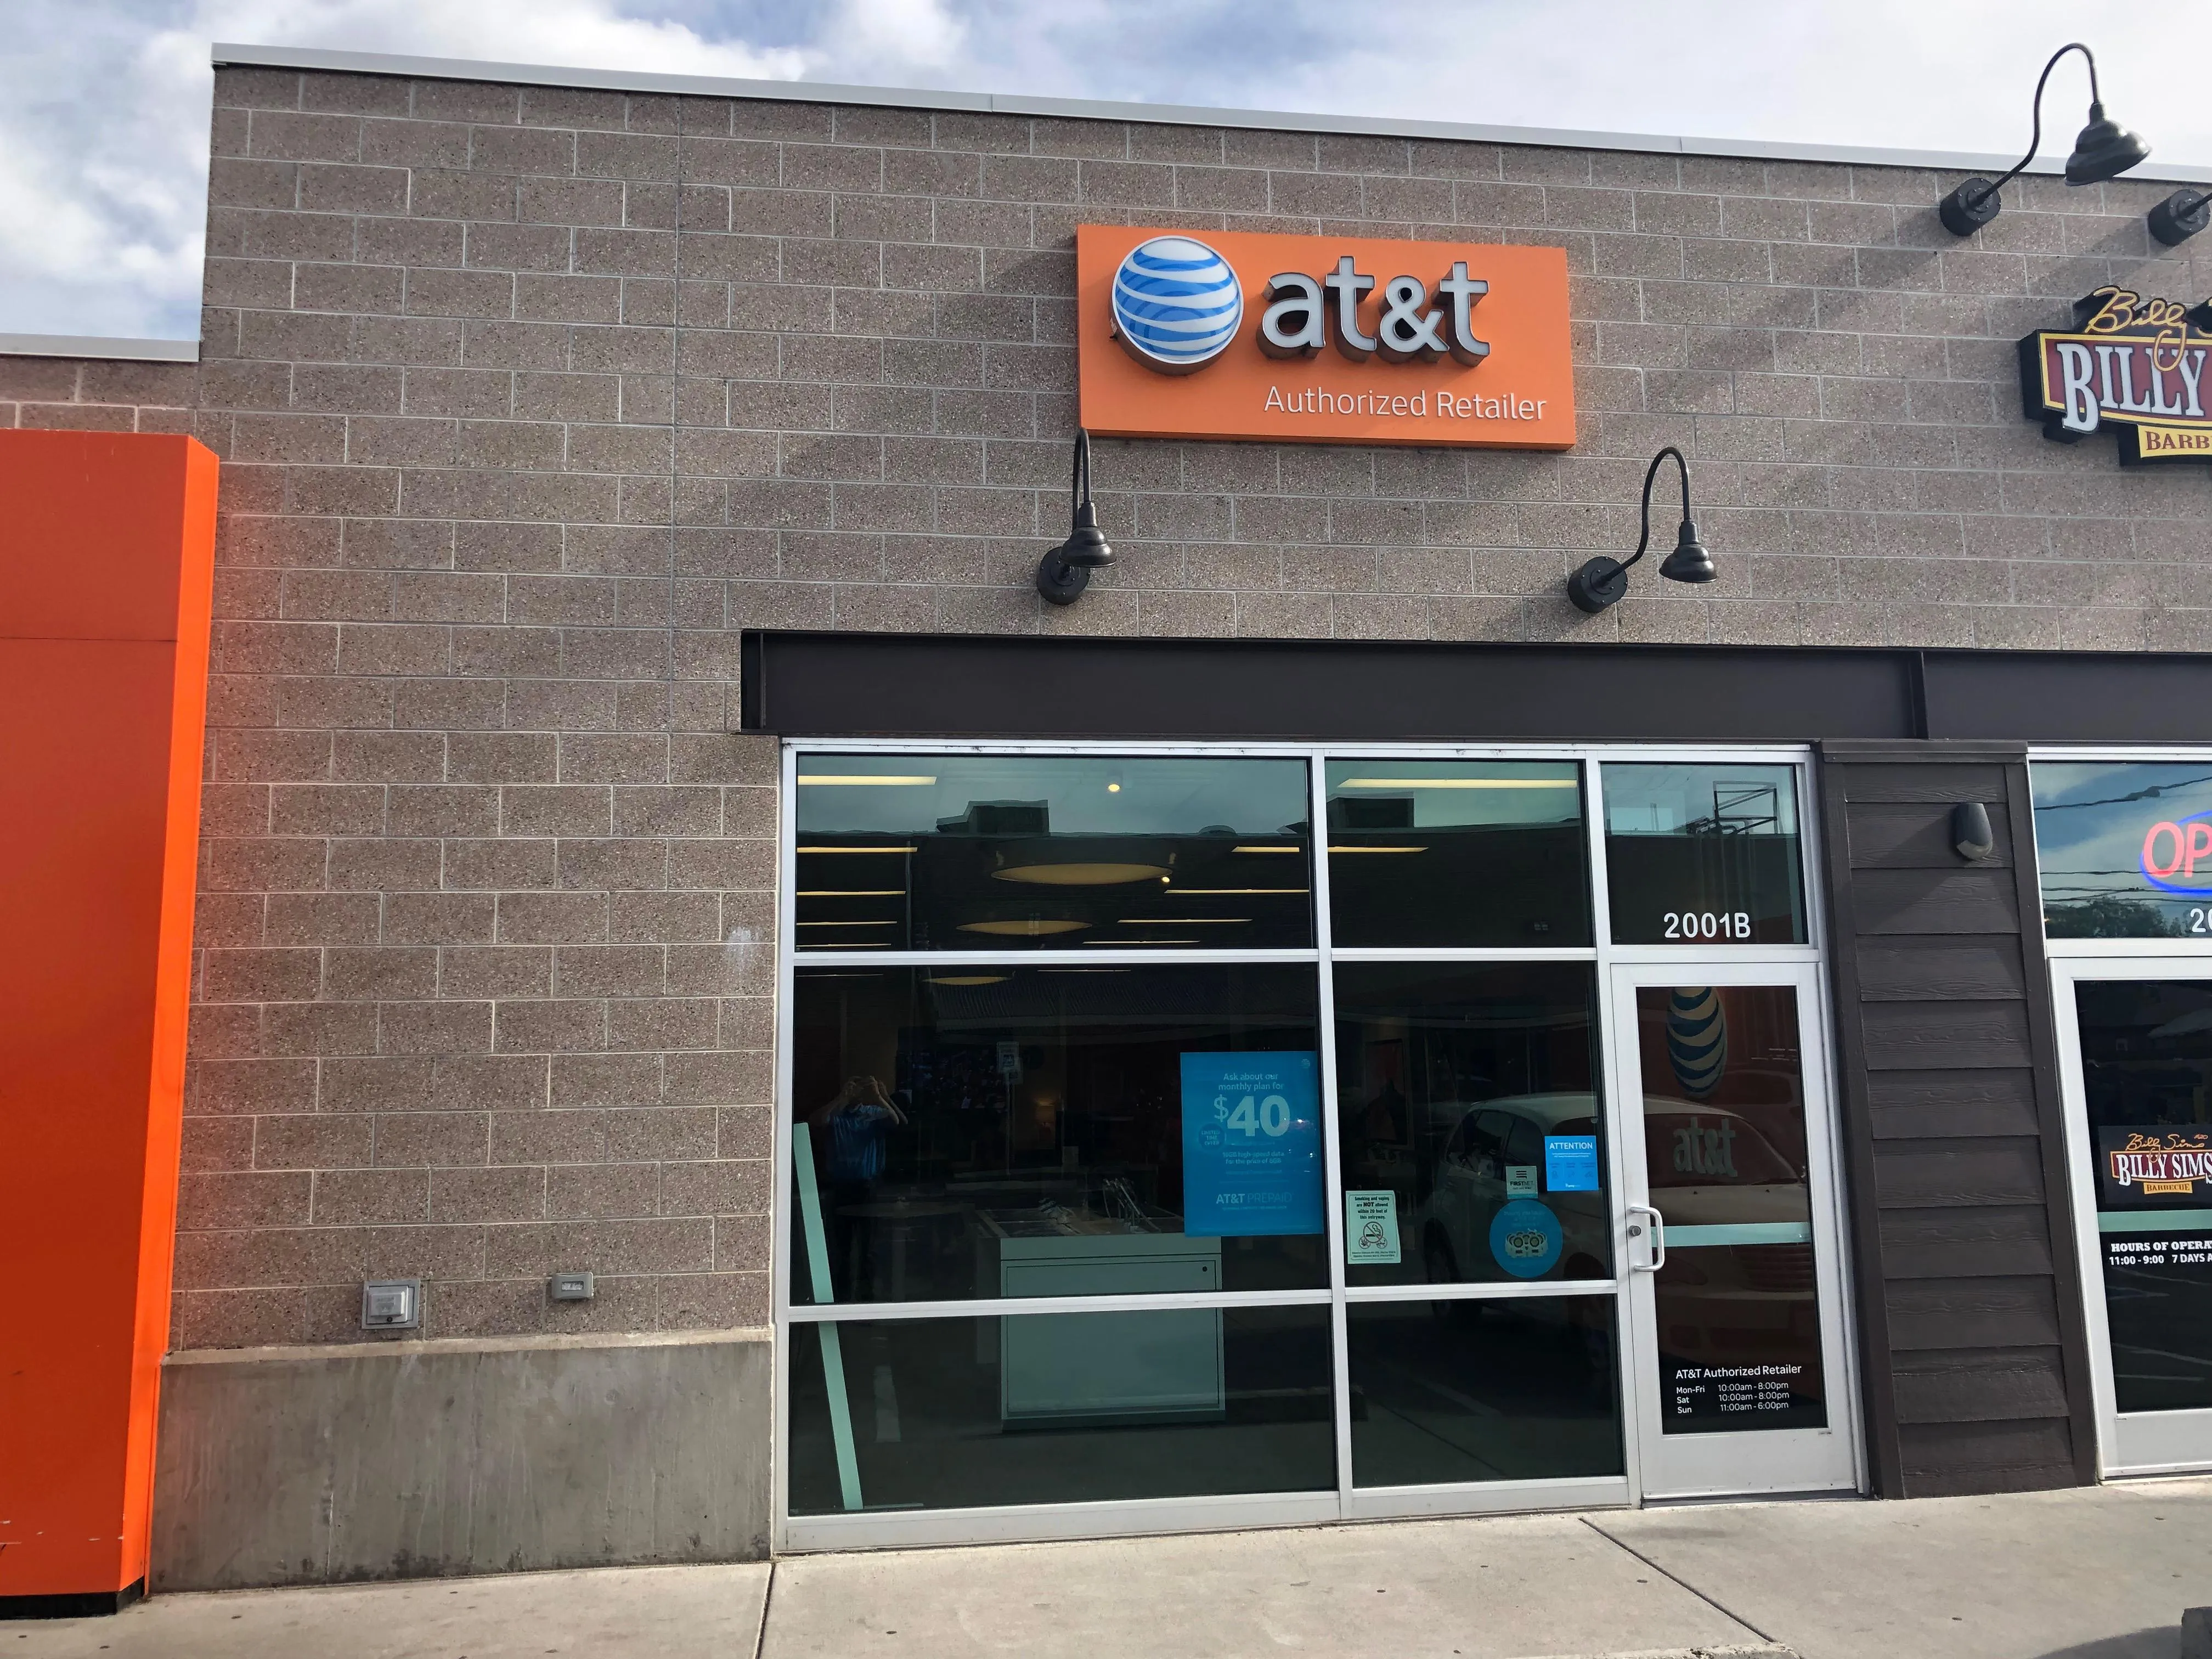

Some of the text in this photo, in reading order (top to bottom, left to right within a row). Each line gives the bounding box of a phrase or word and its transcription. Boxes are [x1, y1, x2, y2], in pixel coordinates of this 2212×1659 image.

[1260, 256, 1491, 360] at&t
[2057, 343, 2206, 432] BILLY
[1264, 386, 1547, 420] Authorized Retailer
[2146, 431, 2210, 450] BARB
[1663, 912, 1751, 938] 2001B
[1218, 1083, 1252, 1092] monthly
[1254, 1082, 1271, 1092] plan
[1214, 1094, 1290, 1137] $40
[1673, 1116, 1738, 1177] at&t
[2116, 1152, 2212, 1186] BILLY SIMS
[2147, 1183, 2191, 1192] BARBECUE
[1216, 1192, 1293, 1204] AT&T PREPAID
[2111, 1242, 2151, 1252] HOURS
[2153, 1242, 2169, 1251] OF
[2109, 1255, 2136, 1265] 11:00
[2143, 1255, 2164, 1264] 9:00
[2171, 1254, 2178, 1263] 7
[2180, 1253, 2205, 1263] DAYS
[1675, 1364, 1802, 1379] AT&T Authorized Retailer
[1676, 1385, 1705, 1395] Mon-Fri
[1718, 1383, 1752, 1392] 10:00am
[1758, 1381, 1789, 1391] 8:00pm
[1718, 1393, 1753, 1402] 10:00am
[1758, 1392, 1790, 1401] 8:00pm
[1720, 1403, 1752, 1412] 11:00am
[1757, 1401, 1789, 1411] 6:00pm
